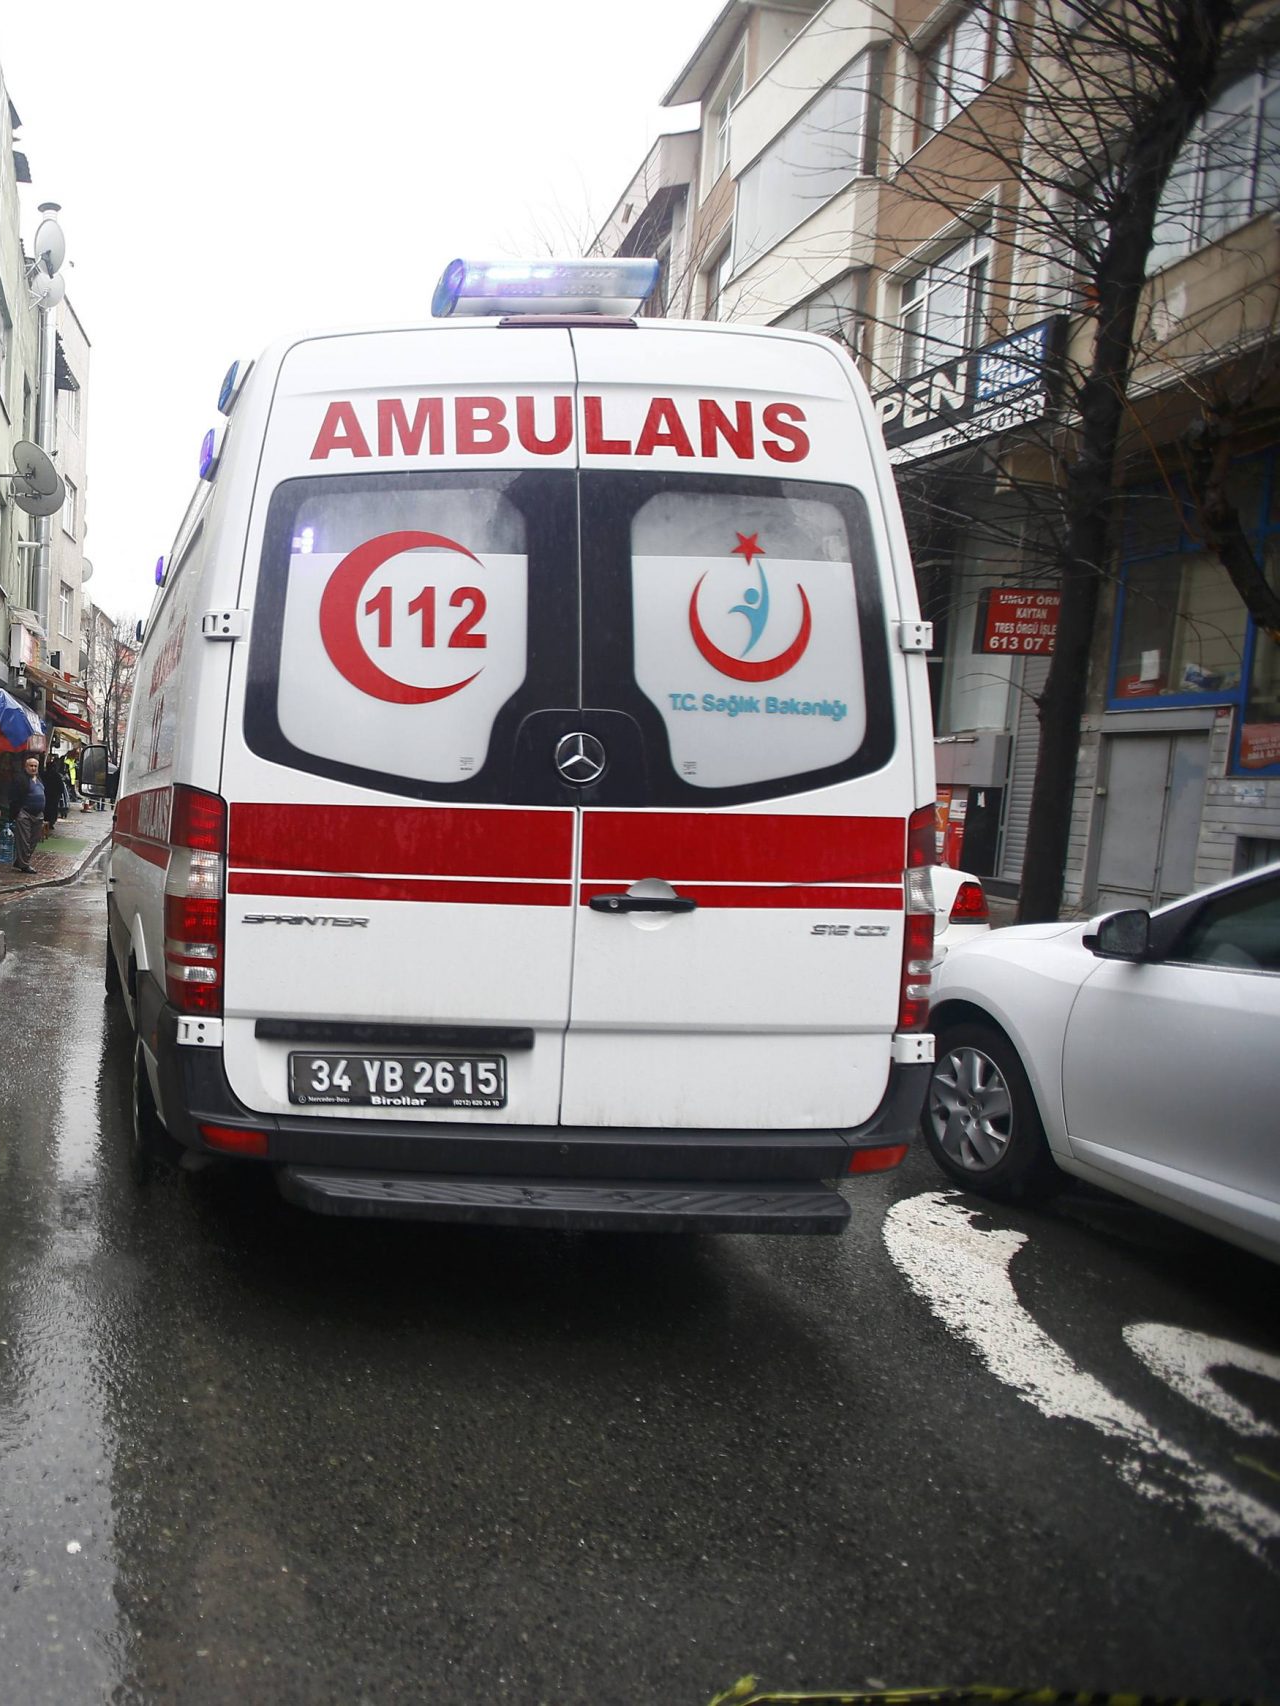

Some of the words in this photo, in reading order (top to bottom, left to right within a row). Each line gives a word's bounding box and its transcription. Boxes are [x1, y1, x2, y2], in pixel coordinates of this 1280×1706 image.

[309, 395, 811, 463] AMBULANS
[364, 585, 488, 650] 112
[1016, 608, 1048, 618] KAYTAN
[989, 636, 1019, 650] 613
[1023, 637, 1044, 651] 07
[668, 693, 698, 711] T.C.
[702, 694, 760, 717] Sağlık
[765, 697, 848, 722] Bakanlığı
[241, 913, 370, 928] SPRINTER
[311, 1059, 352, 1093] 34
[363, 1060, 404, 1094] YB
[413, 1061, 499, 1095] 2615
[370, 1096, 427, 1106] Birollar
